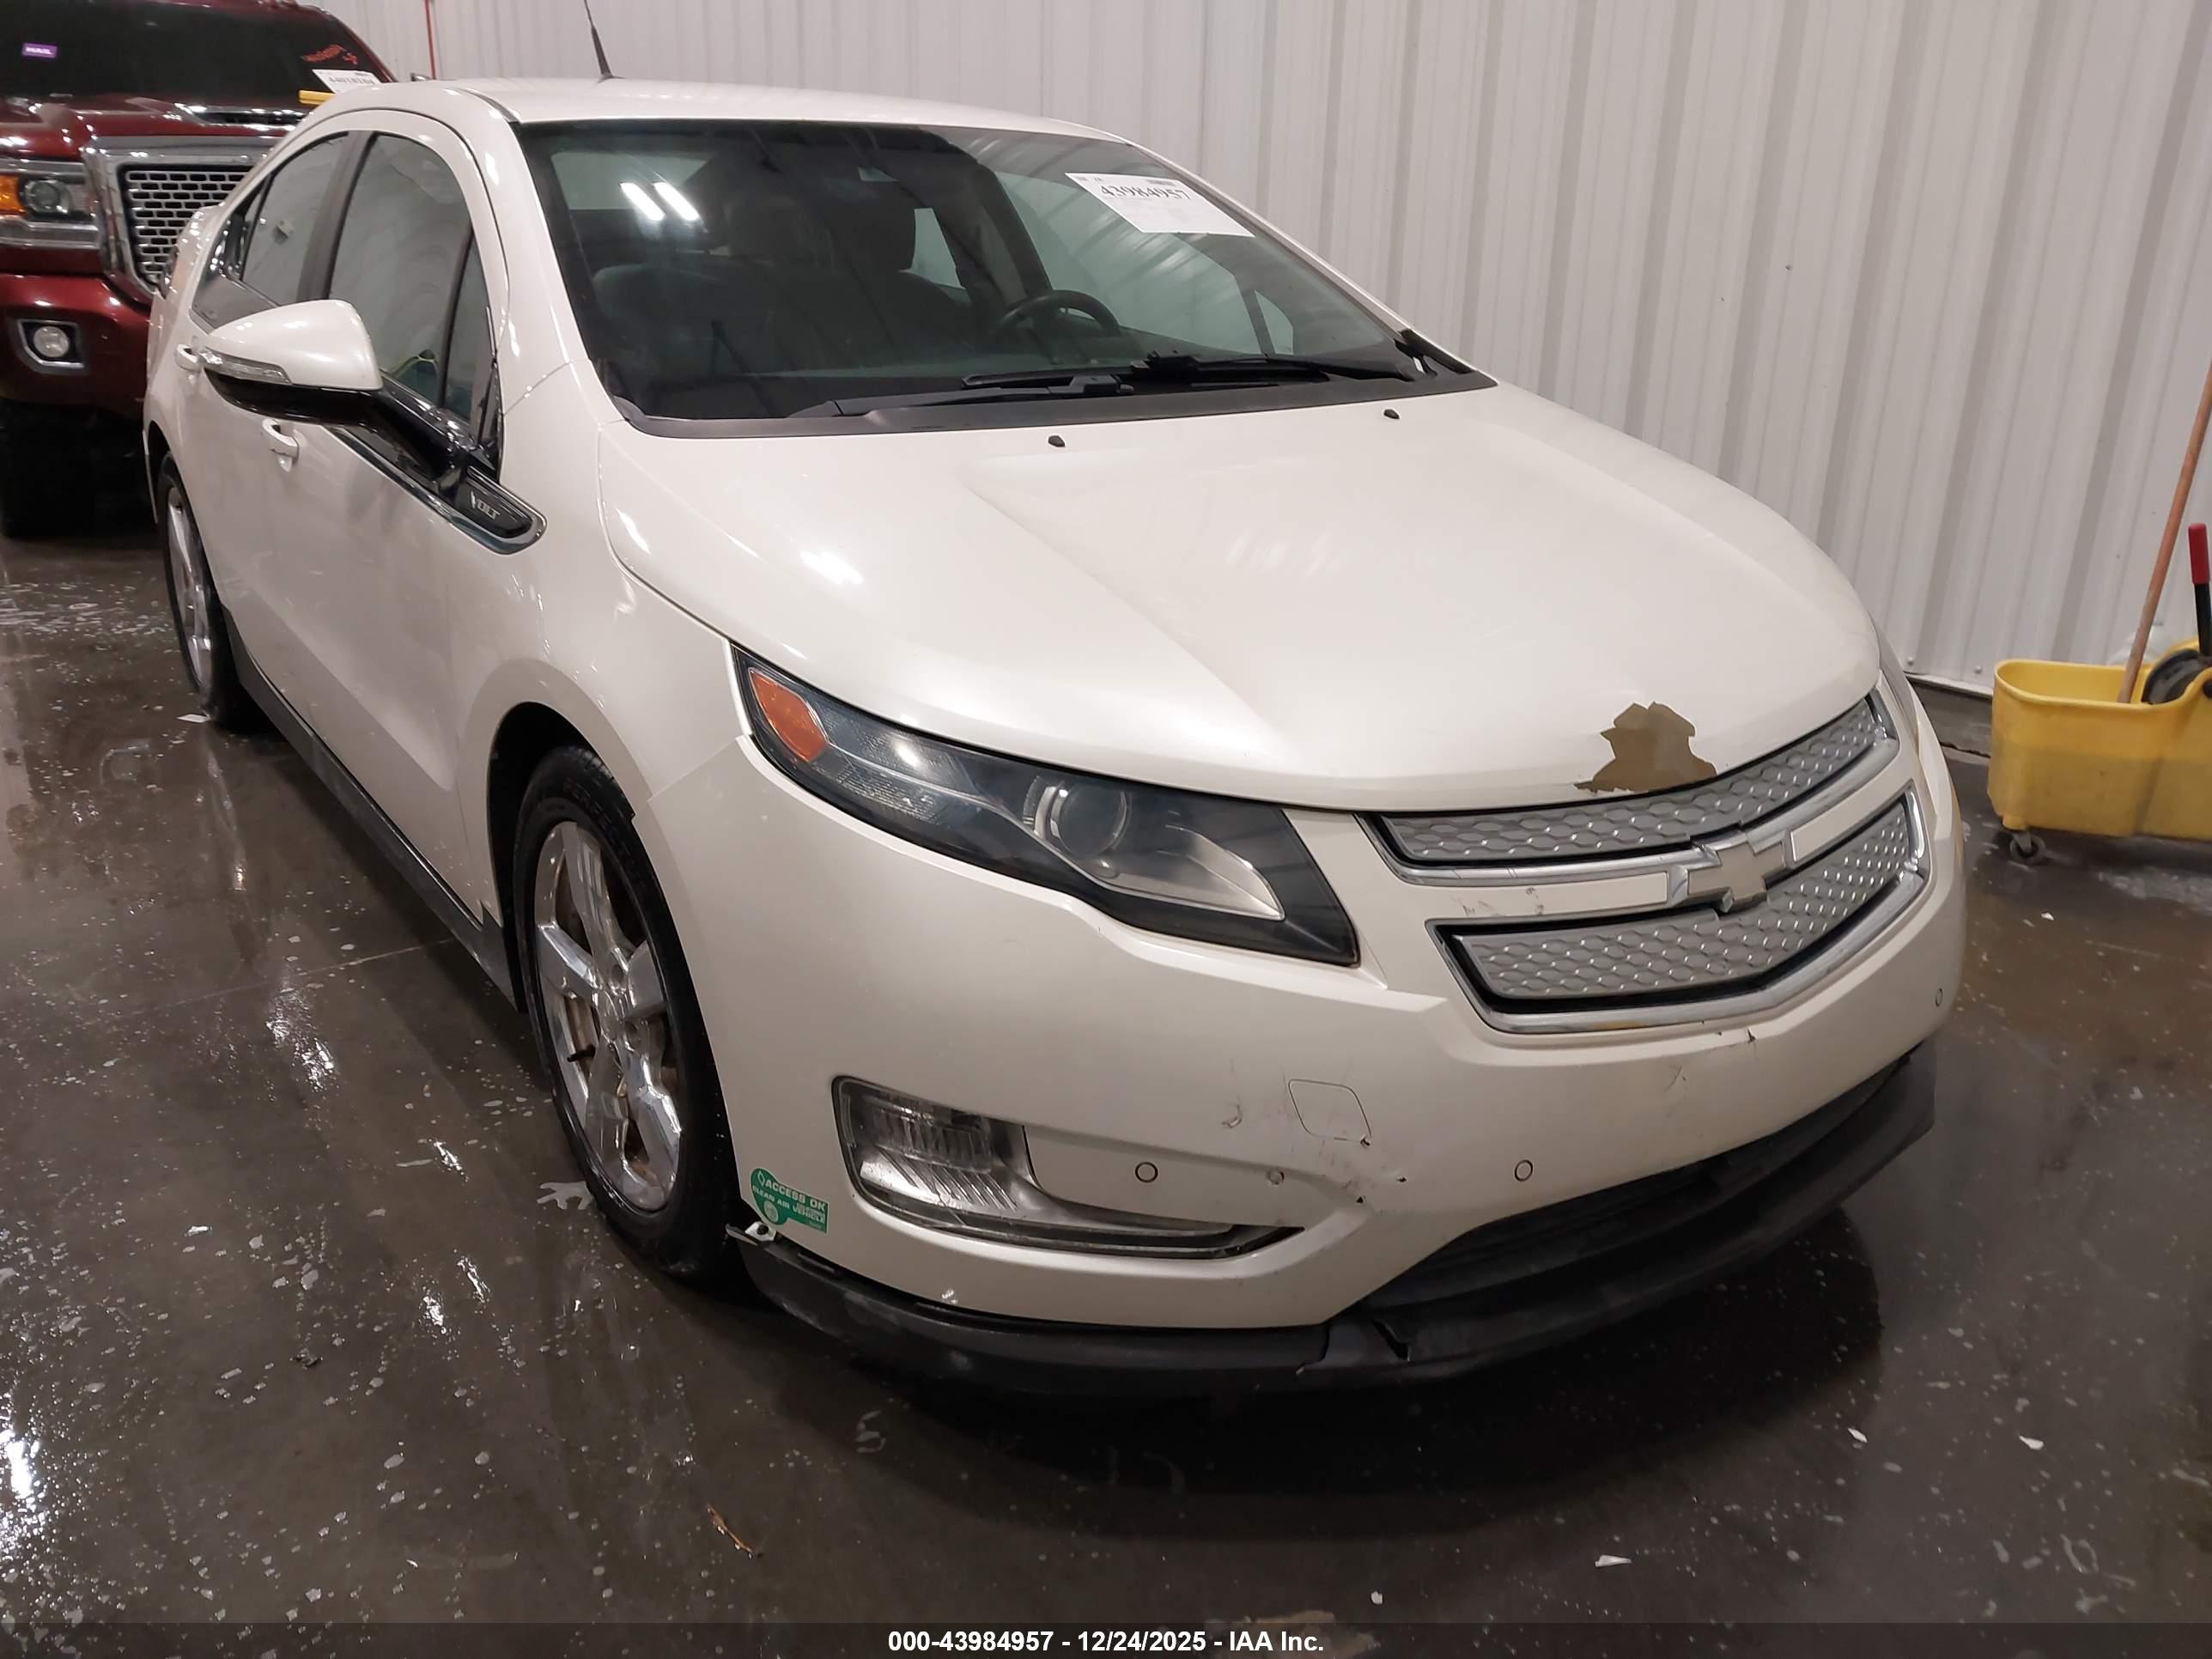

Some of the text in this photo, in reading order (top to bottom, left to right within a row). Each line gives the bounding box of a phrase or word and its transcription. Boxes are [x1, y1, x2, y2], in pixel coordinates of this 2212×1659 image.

[1100, 185, 1191, 200] 43984957
[471, 490, 501, 520] VOLT
[752, 1185, 775, 1202] CLEAN
[777, 1199, 790, 1209] AIR
[793, 1205, 825, 1224] VEHICLE
[765, 1178, 806, 1204] ACCESS
[810, 1197, 826, 1211] OK
